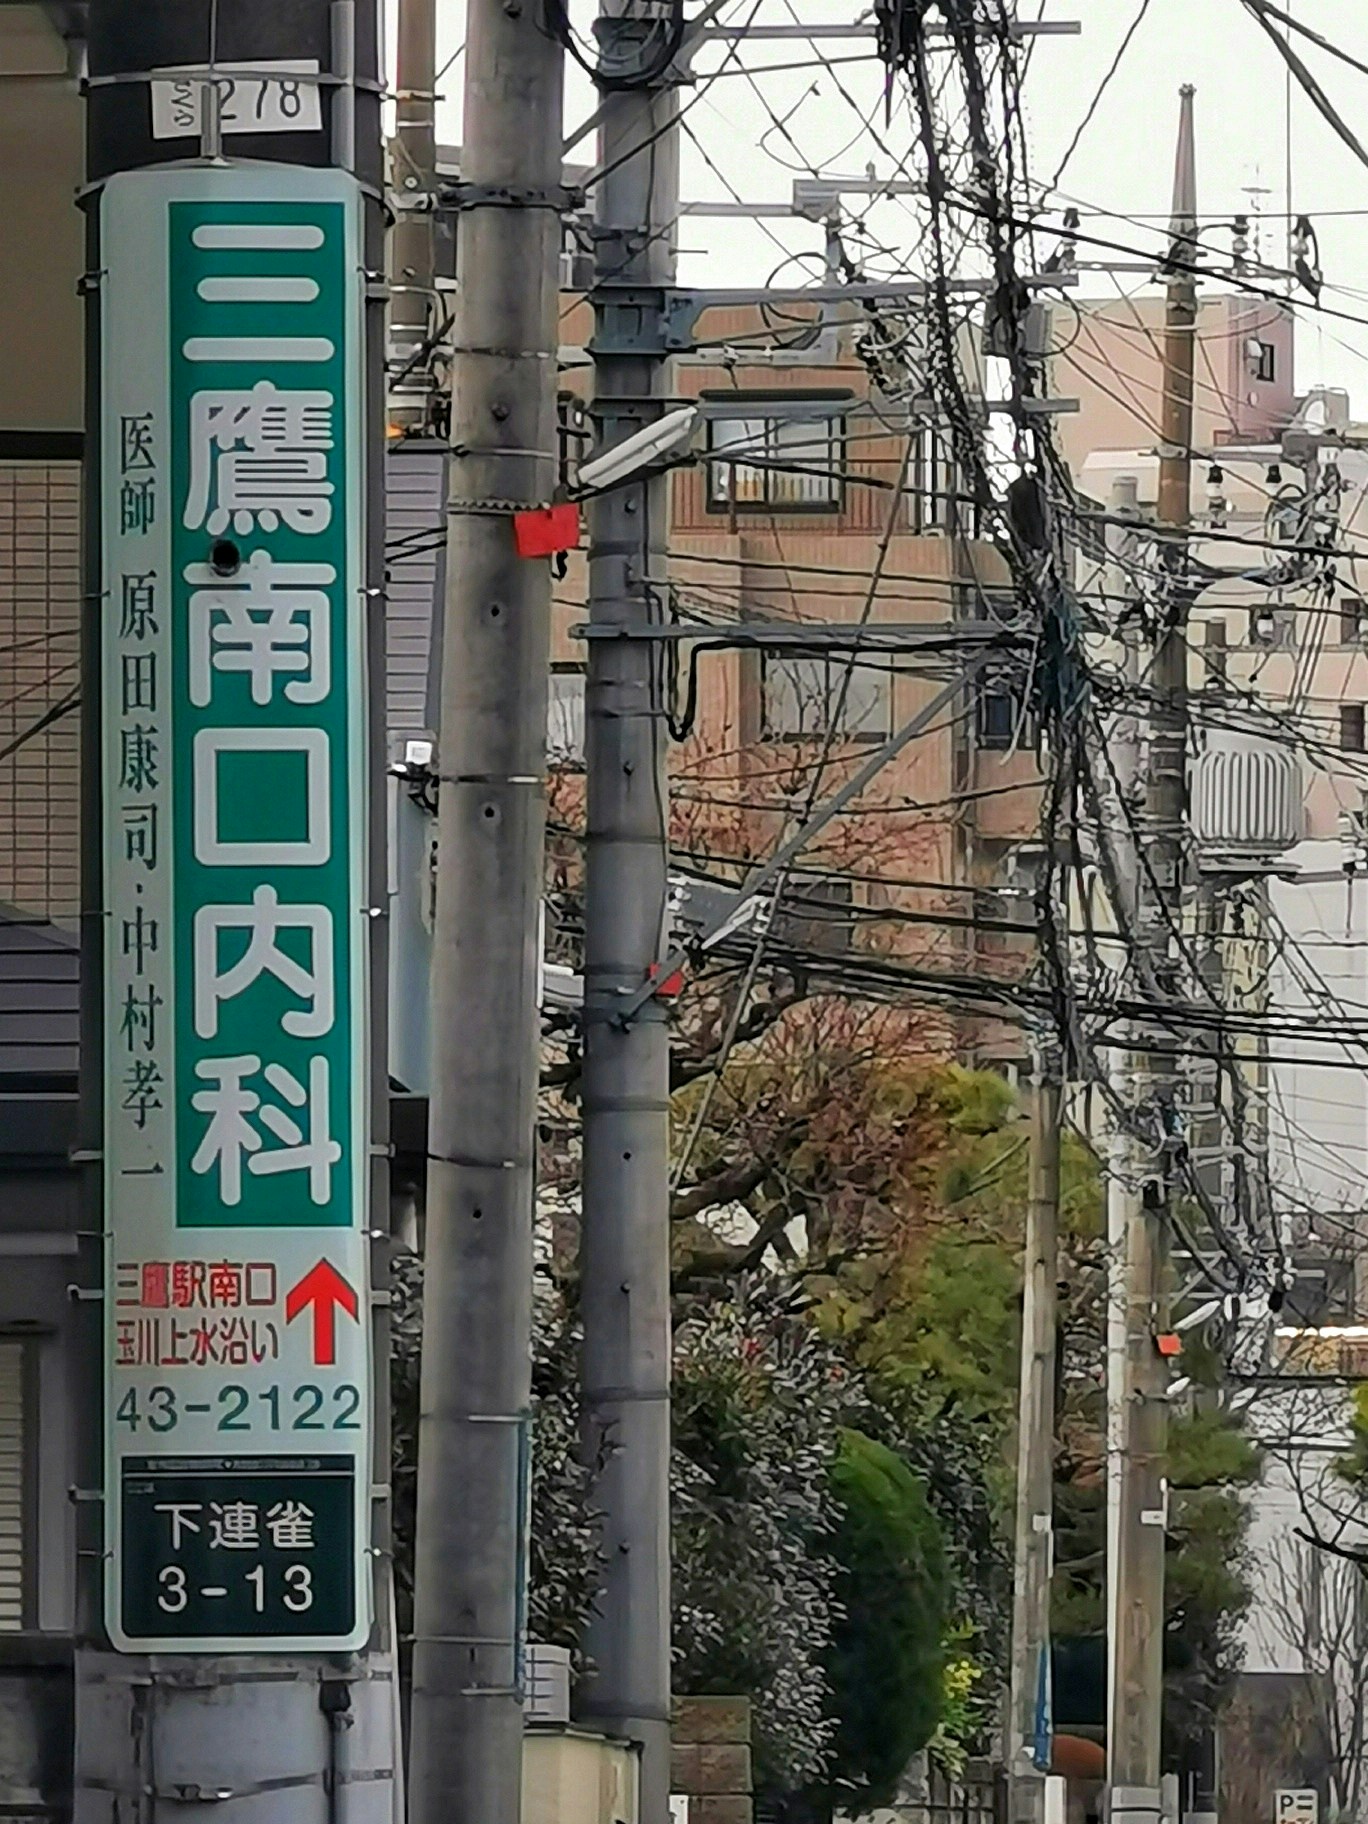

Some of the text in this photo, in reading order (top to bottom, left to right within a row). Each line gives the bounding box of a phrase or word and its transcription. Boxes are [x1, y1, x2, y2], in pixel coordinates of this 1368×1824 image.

[119, 411, 156, 537] 医師
[182, 224, 342, 1206] 三鷹南口内科
[115, 1258, 277, 1309] 三鷹駅南口
[115, 1316, 279, 1367] 玉川上水沿い
[115, 1384, 362, 1433] 43-2122
[154, 1500, 316, 1550] 下連雀
[157, 1563, 314, 1613] 3-13
